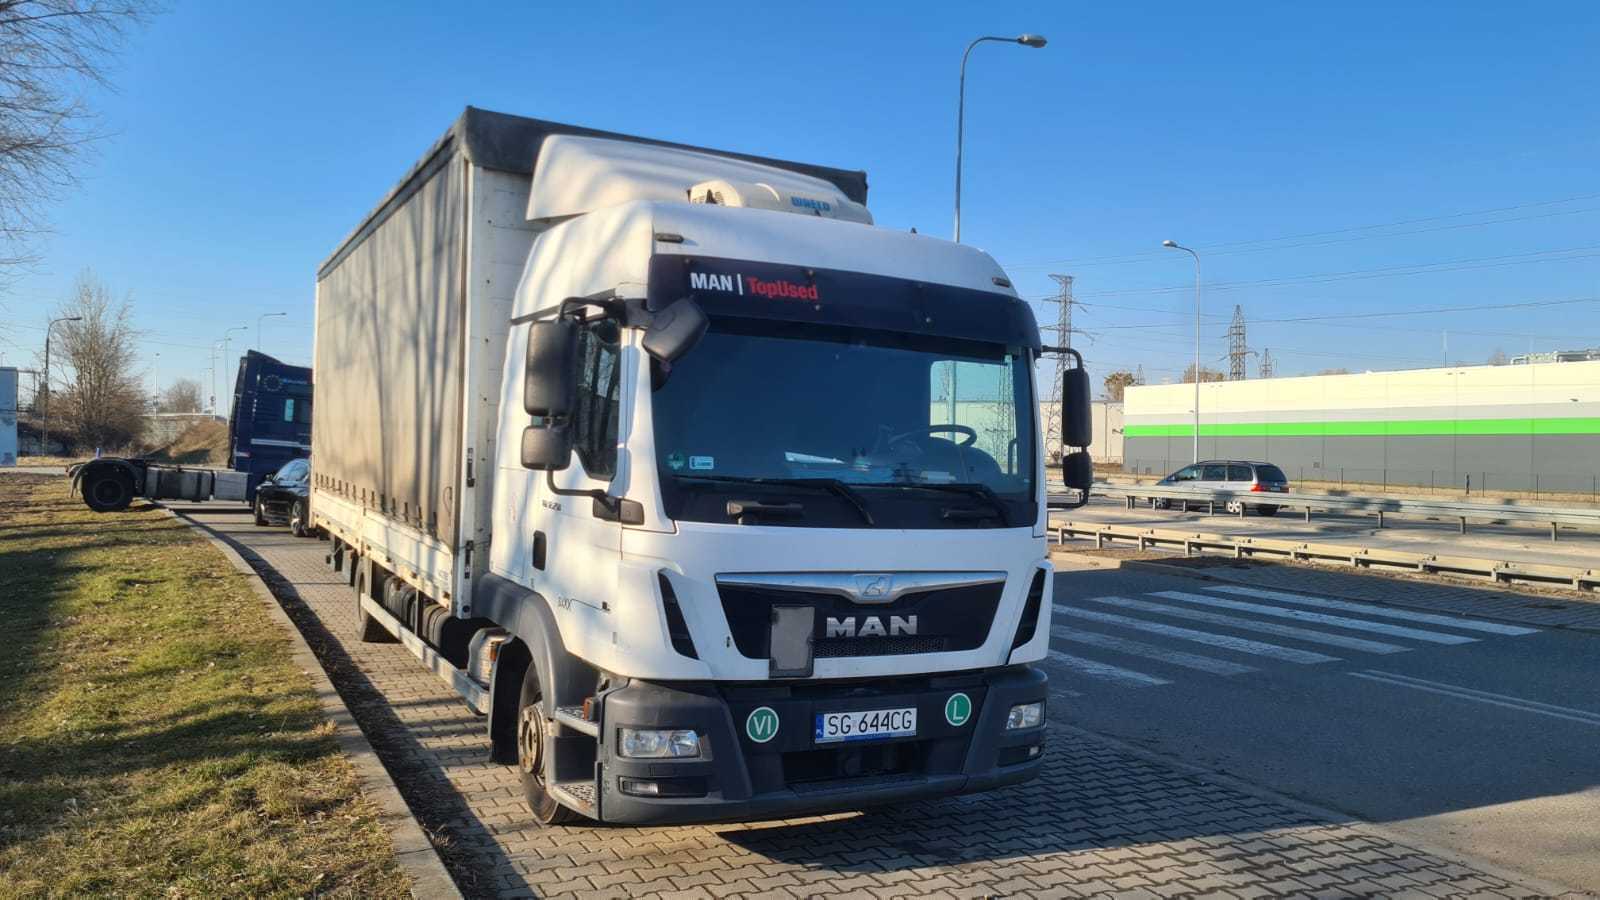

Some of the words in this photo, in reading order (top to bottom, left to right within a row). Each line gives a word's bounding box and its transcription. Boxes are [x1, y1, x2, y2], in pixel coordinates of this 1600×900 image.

[690, 272, 733, 292] MAN
[747, 277, 818, 300] TopUsed
[826, 615, 918, 637] MAN
[952, 700, 964, 720] L
[752, 715, 772, 736] VI
[828, 714, 851, 736] SG
[858, 710, 912, 733] 644CG
